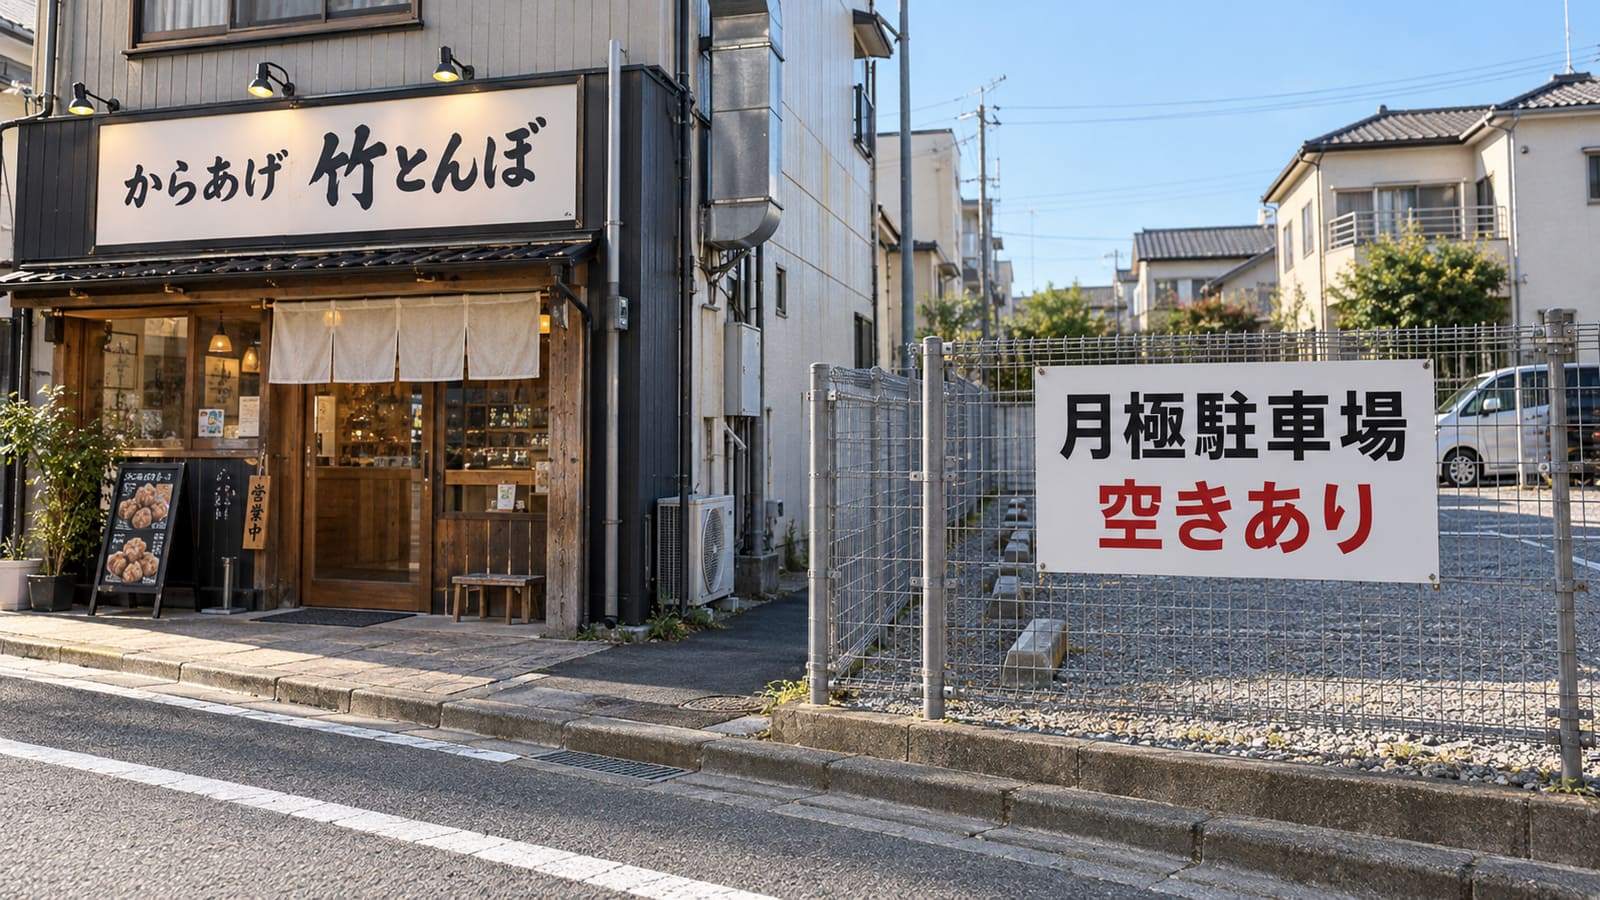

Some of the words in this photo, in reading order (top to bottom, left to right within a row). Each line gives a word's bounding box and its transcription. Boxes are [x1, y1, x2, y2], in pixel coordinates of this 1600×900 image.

[124, 149, 289, 209] からあげ
[308, 116, 547, 211] 竹とんぼ
[1059, 389, 1408, 462] 月極駐車場
[248, 483, 267, 543] 営業中
[1098, 478, 1373, 555] 空きあり
